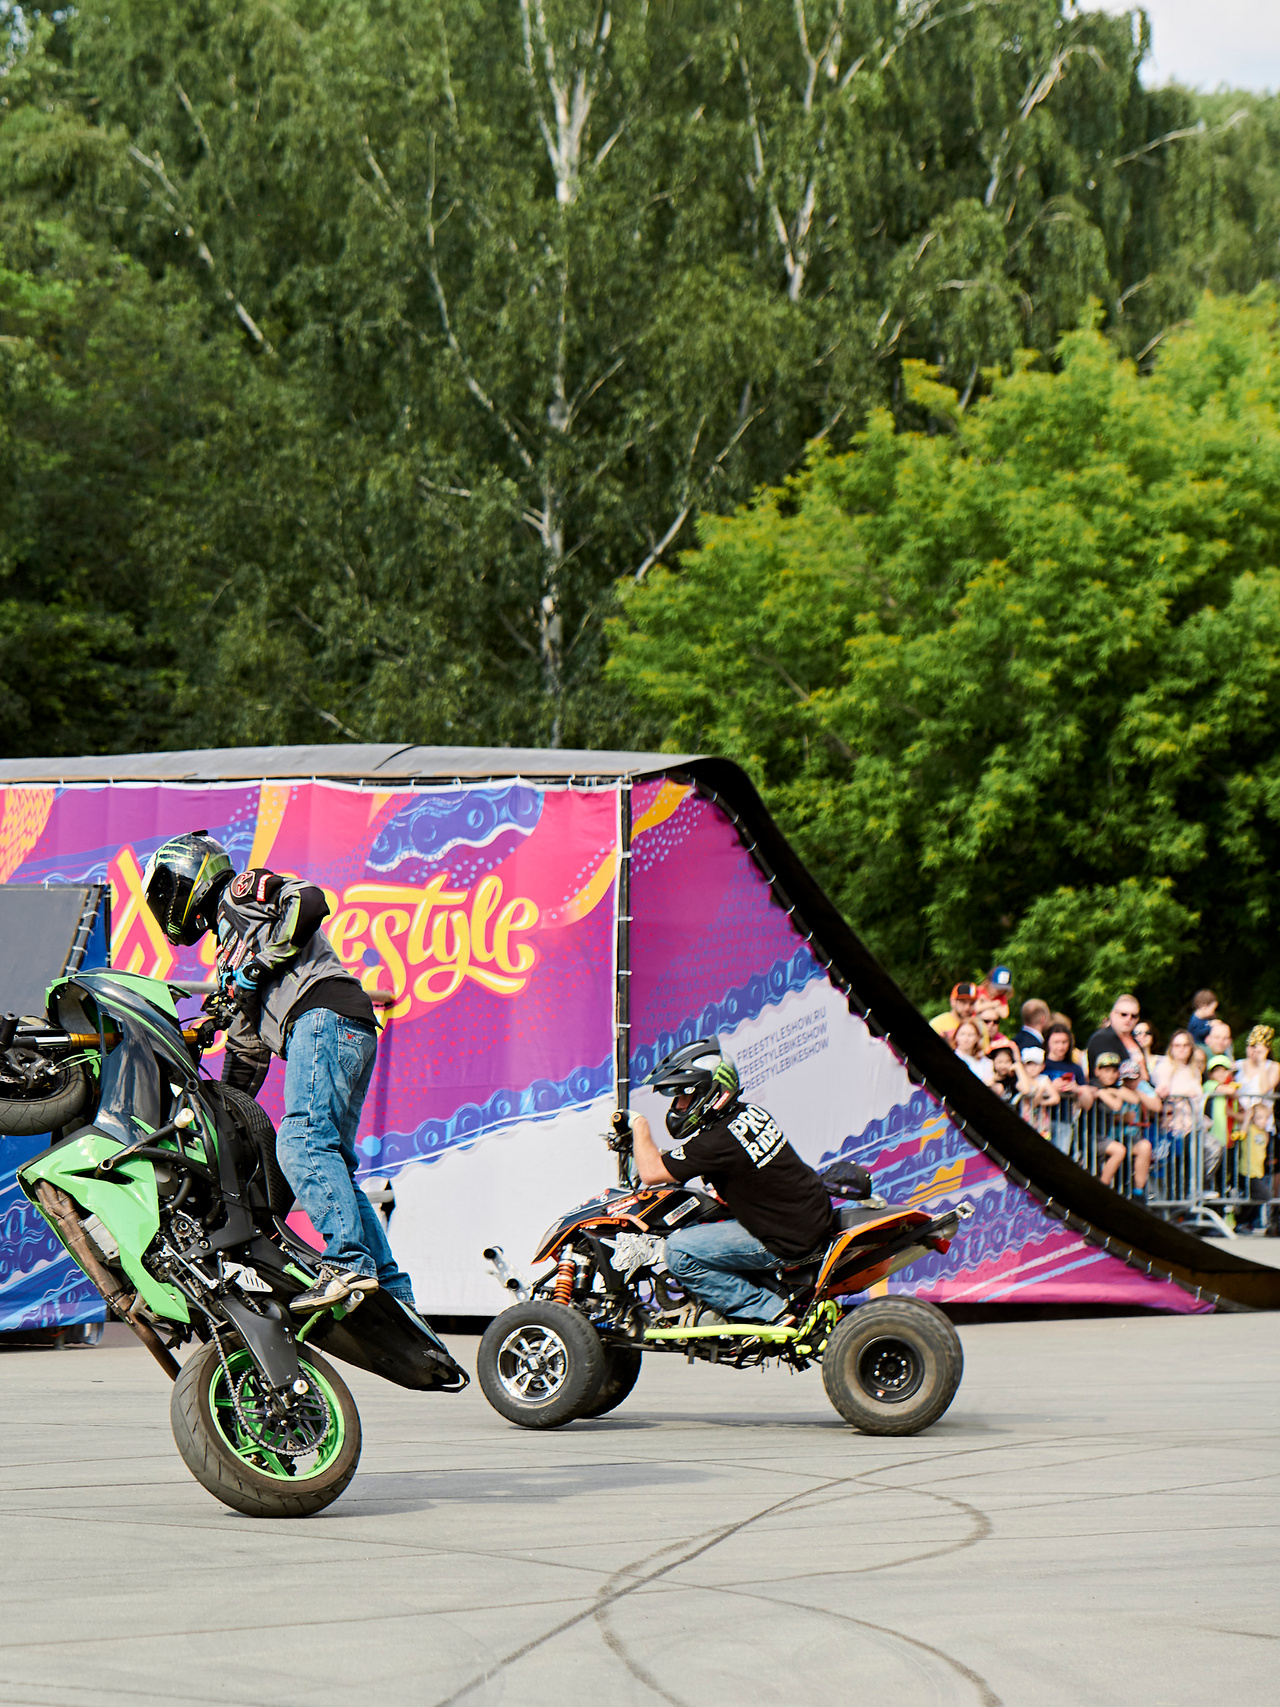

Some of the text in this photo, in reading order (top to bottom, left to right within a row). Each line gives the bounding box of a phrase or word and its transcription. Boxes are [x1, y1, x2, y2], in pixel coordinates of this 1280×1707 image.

[737, 1006, 827, 1063] FREESTYLESHOW.RU
[738, 1021, 828, 1077] FREESTYLEBIKESHOW
[727, 1103, 771, 1148] PRO
[745, 1118, 783, 1163] RIDE
